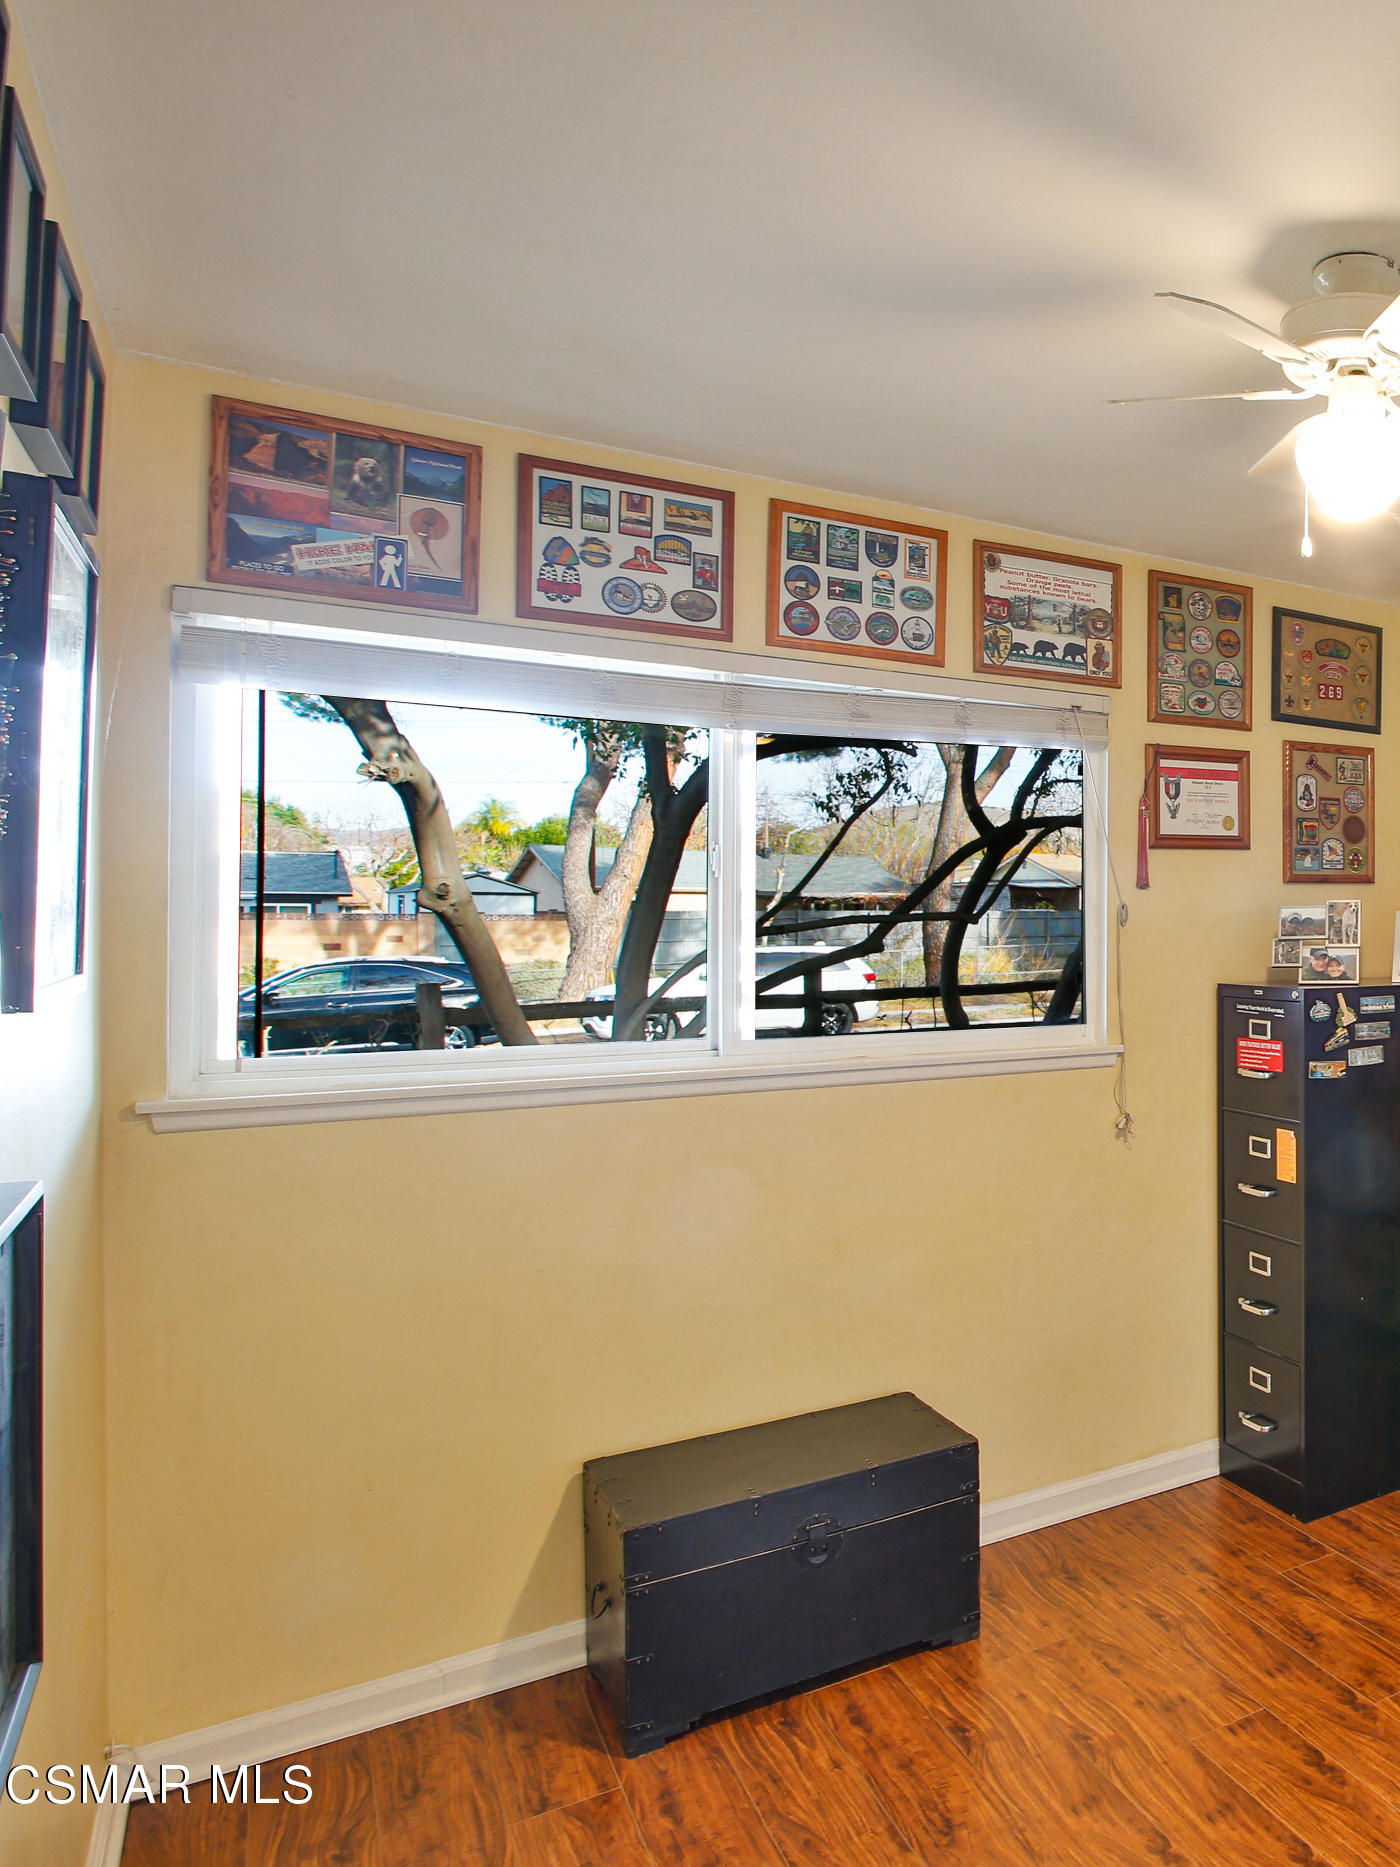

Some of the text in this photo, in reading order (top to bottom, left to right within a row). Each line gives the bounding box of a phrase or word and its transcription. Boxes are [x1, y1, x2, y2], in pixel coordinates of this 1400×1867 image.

[239, 560, 258, 568] PLACES
[272, 563, 285, 571] GO
[1000, 568, 1024, 576] Peanut
[1053, 577, 1080, 585] Granola
[1026, 578, 1052, 586] Orange
[1000, 585, 1040, 594] substances
[1043, 590, 1065, 598] known
[1319, 684, 1344, 699] 269
